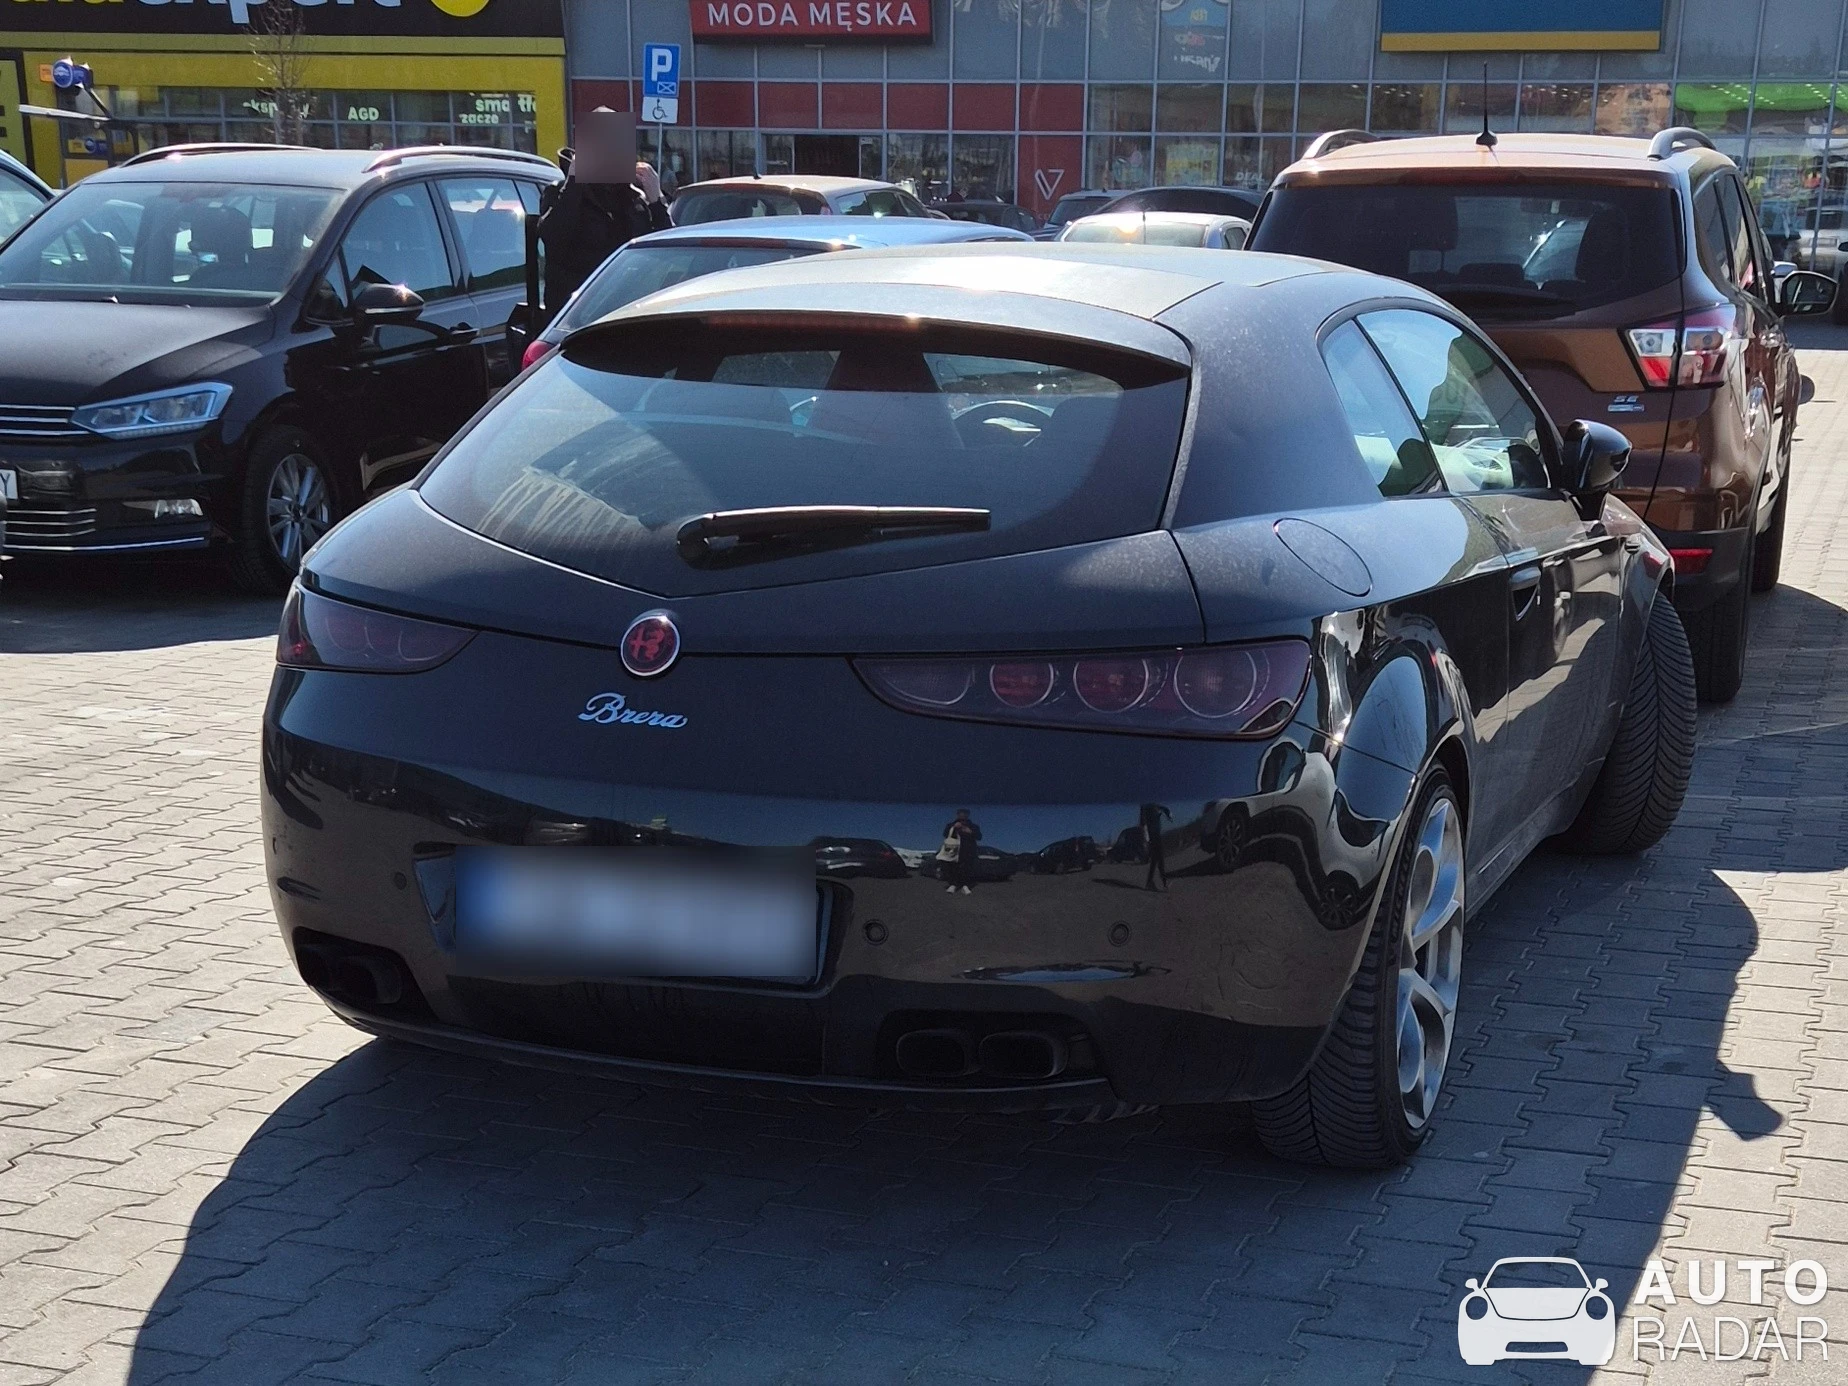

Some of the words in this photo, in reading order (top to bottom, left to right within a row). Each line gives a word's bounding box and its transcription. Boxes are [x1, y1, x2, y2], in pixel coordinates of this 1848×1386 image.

[708, 2, 799, 27] MODA
[809, 2, 917, 32] MĘSKA
[651, 48, 673, 82] P
[348, 106, 380, 121] AGD
[578, 692, 688, 728] Brera
